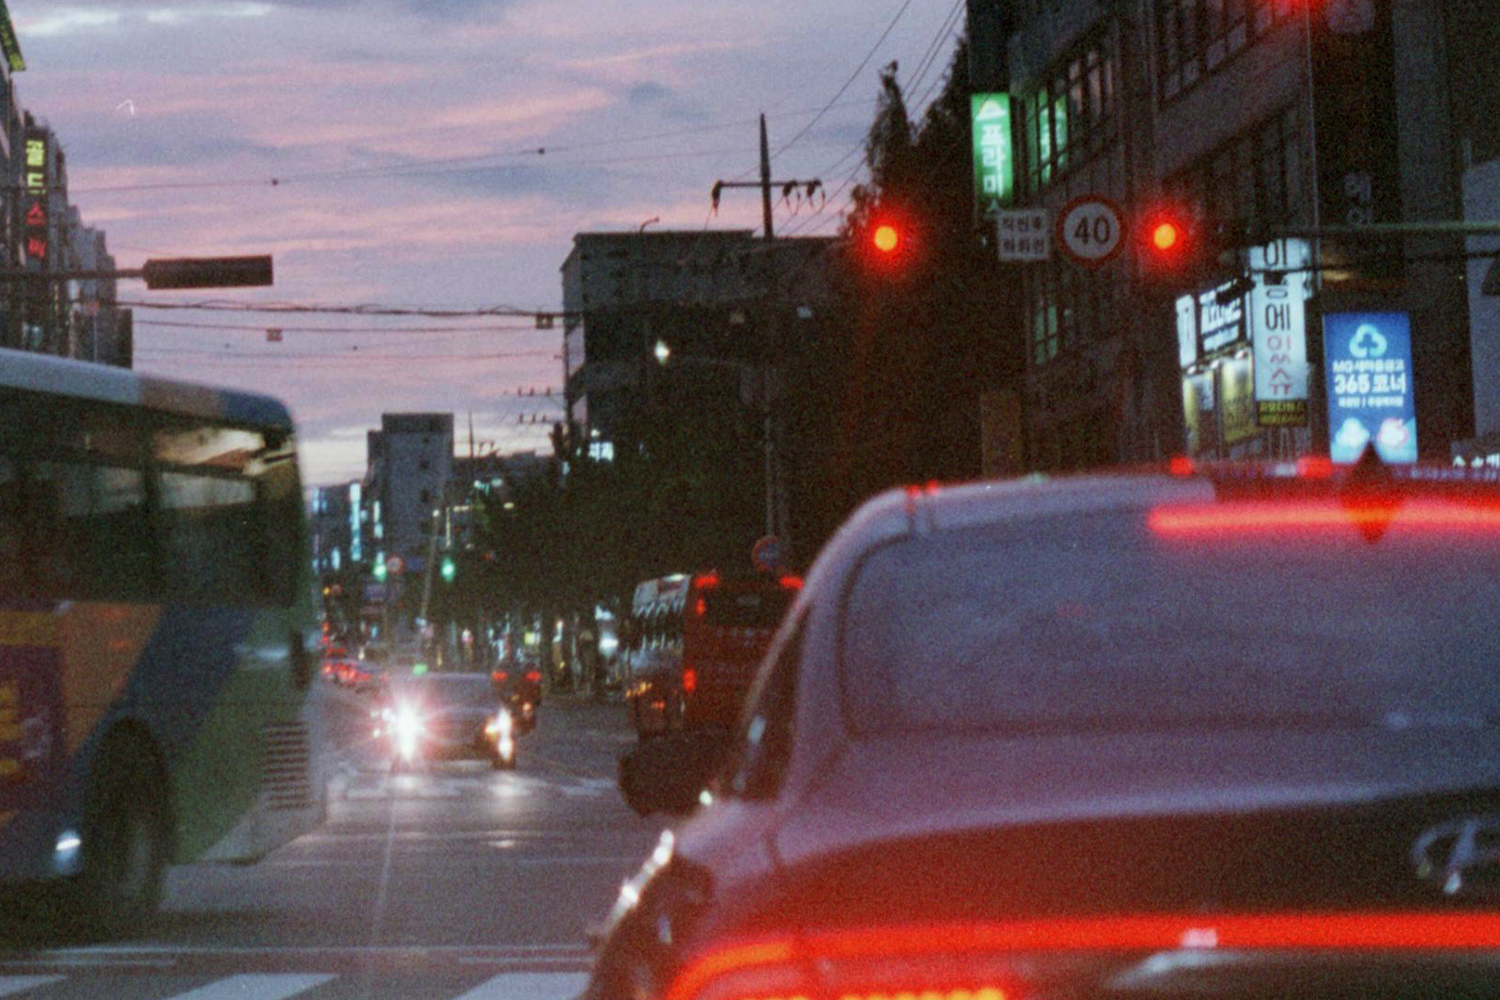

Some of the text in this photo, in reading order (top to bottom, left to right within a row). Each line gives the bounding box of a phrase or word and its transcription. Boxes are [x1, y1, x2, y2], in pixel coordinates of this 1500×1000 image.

[1073, 214, 1112, 245] 40
[1334, 372, 1407, 396] 365 코너
